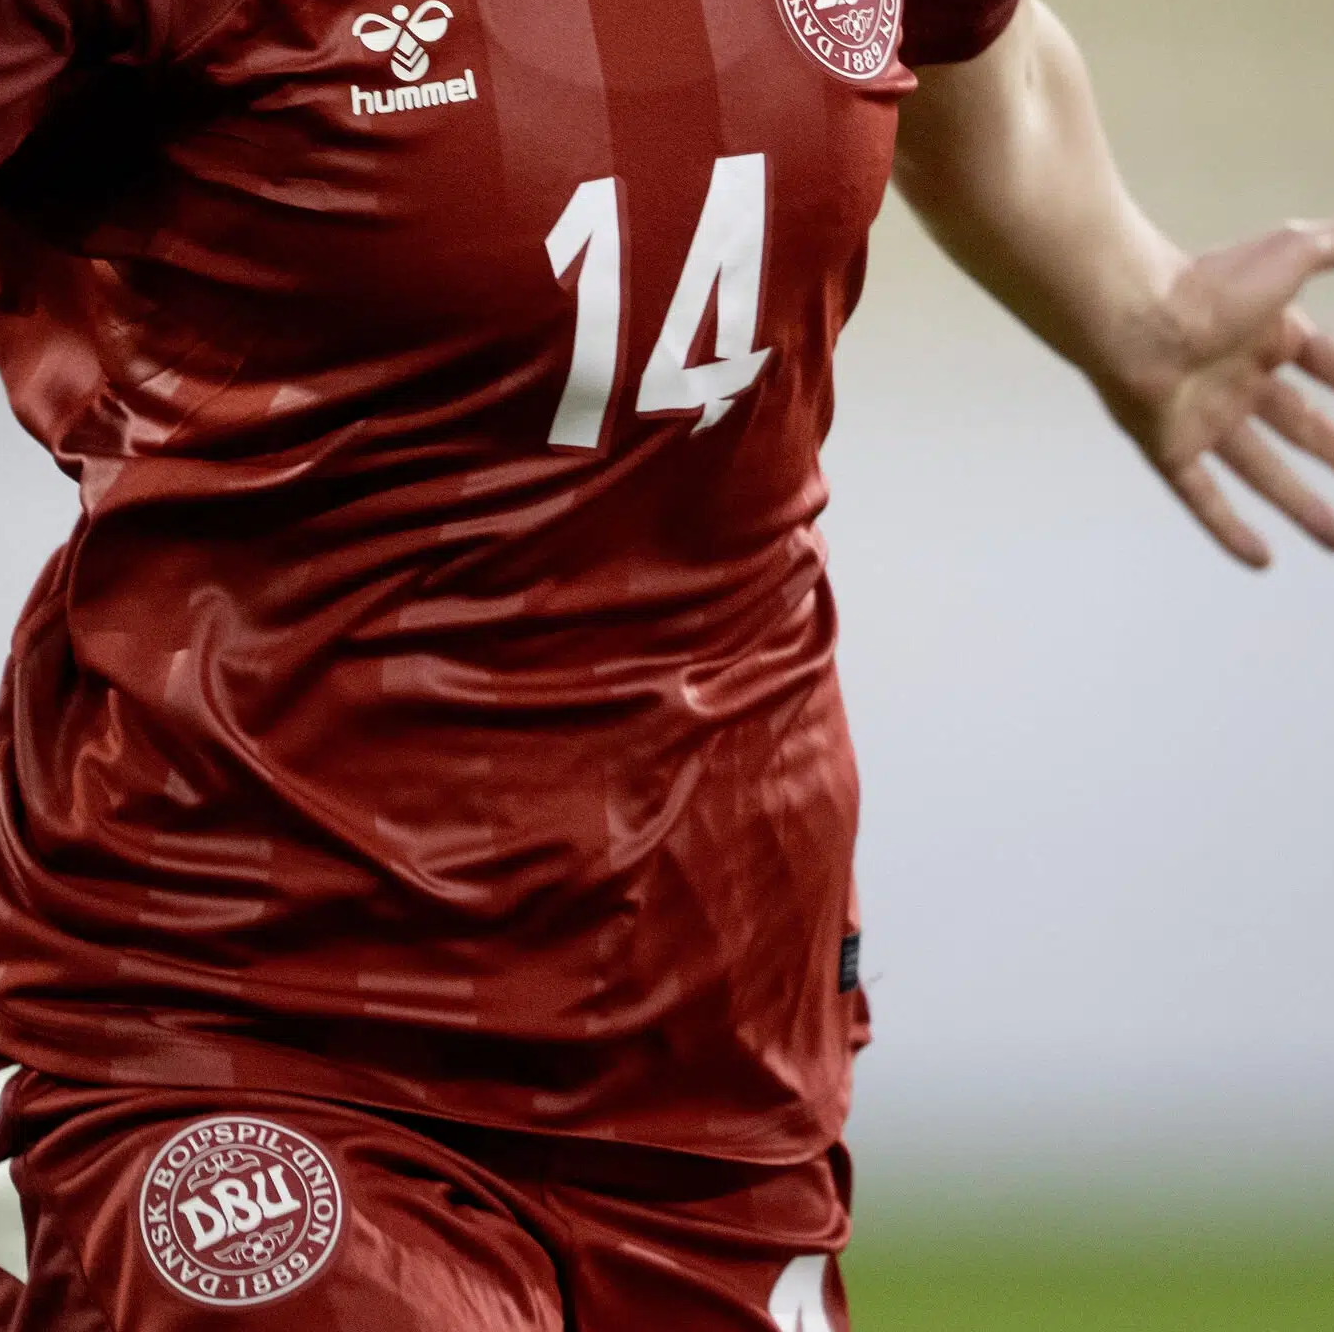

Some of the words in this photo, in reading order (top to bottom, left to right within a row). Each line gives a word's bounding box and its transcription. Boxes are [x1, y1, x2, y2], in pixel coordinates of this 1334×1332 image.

[350, 68, 478, 116] hummel
[842, 45, 883, 73] 1889
[544, 152, 773, 449] 14
[177, 1163, 301, 1252] DBU
[147, 1199, 221, 1296] DANSK
[236, 1251, 309, 1298] 1889
